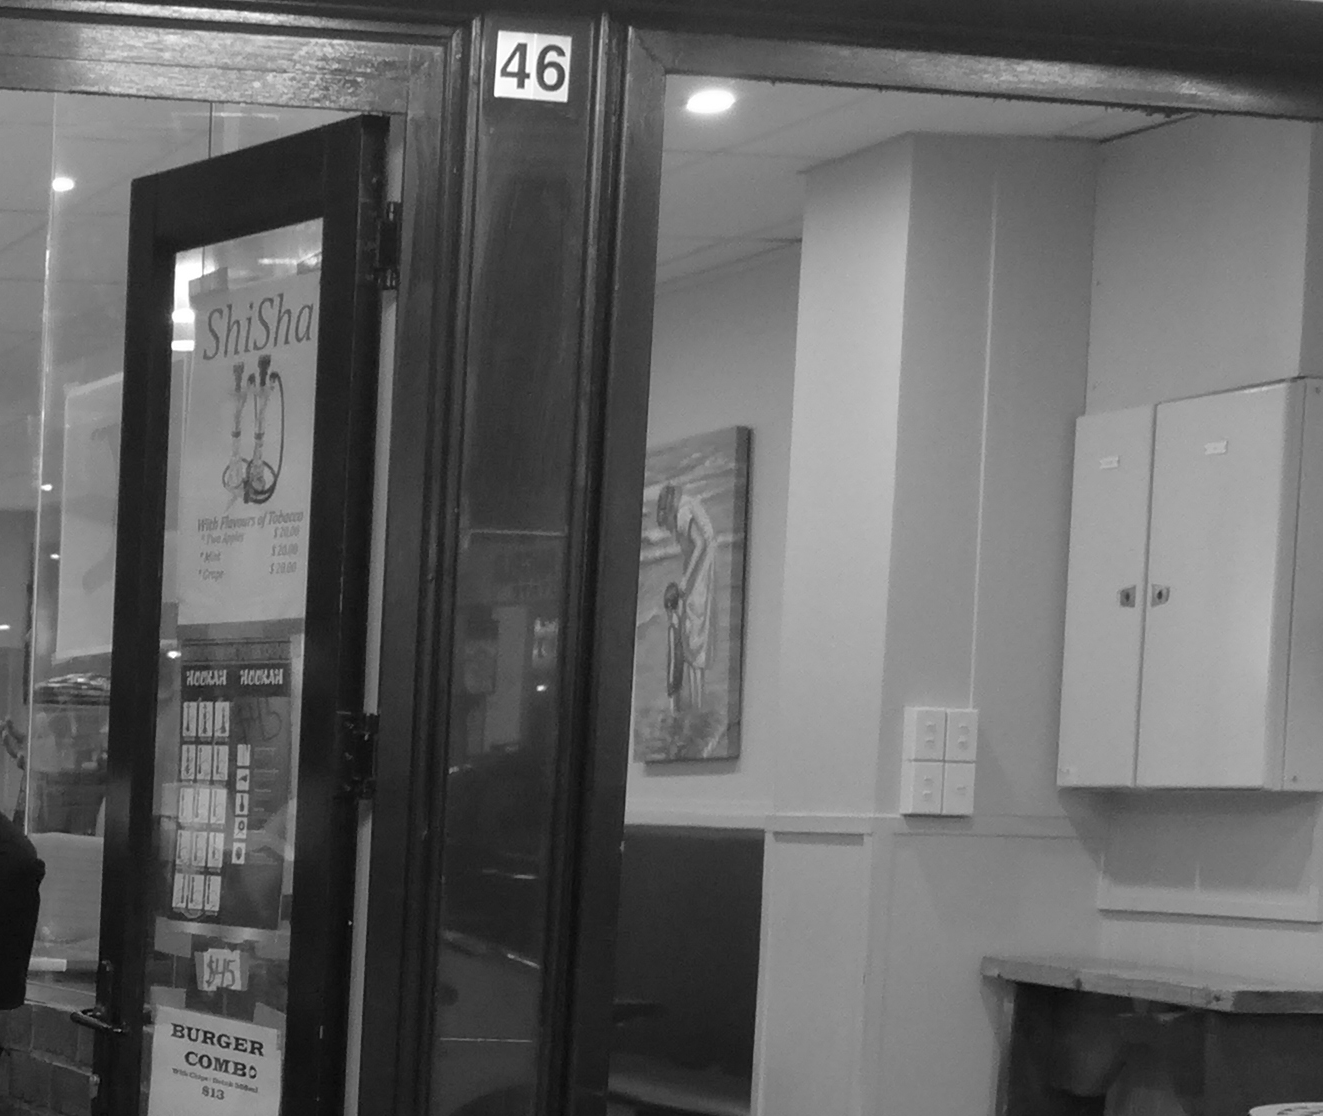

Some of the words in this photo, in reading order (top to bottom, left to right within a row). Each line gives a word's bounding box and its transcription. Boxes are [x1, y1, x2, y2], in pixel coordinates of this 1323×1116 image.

[500, 42, 566, 92] 46
[202, 293, 314, 360] ShiSha
[268, 509, 304, 526] Tobacco
[205, 954, 236, 989] $45
[170, 1022, 264, 1057] BURGER
[183, 1050, 258, 1080] COMBO
